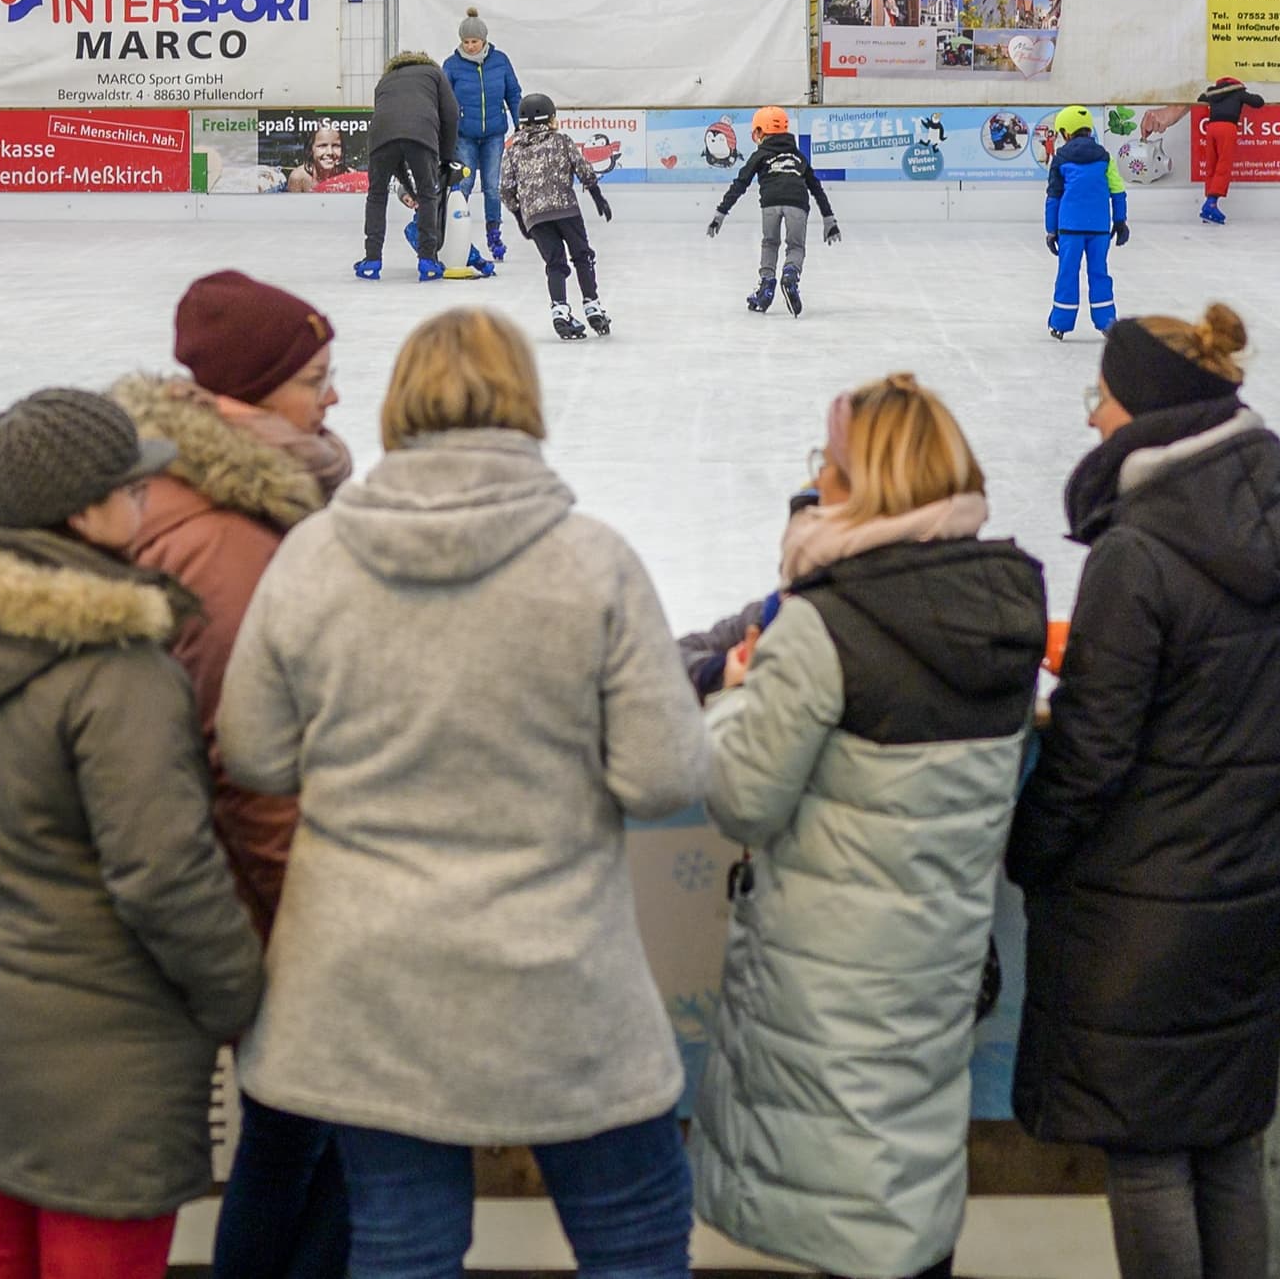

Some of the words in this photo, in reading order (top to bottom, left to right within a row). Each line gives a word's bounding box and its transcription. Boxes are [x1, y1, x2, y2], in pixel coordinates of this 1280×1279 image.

[1212, 12, 1230, 20] Tel.
[1237, 12, 1266, 20] 07552
[1212, 23, 1232, 31] Mail
[76, 29, 247, 61] MARCO
[1212, 34, 1232, 42] Web
[97, 73, 146, 86] MARCO
[149, 72, 182, 87] Sport
[185, 73, 224, 86] GmbH
[58, 88, 134, 103] Bergwaldstr.
[136, 89, 145, 101] 4
[153, 88, 191, 101] 88630
[194, 87, 265, 102] Pfullendorf
[828, 109, 889, 123] Pfullendorfer
[202, 116, 296, 137] Freizeitspaß
[299, 118, 319, 132] im
[53, 121, 77, 136] Fair.
[80, 125, 150, 145] Menschlich.
[152, 133, 180, 148] Nah.
[812, 142, 827, 153] im
[828, 138, 870, 153] Seepark
[871, 134, 911, 149] Linzgau
[1256, 138, 1268, 146] tun
[913, 148, 931, 157] Das
[911, 164, 936, 174] Event
